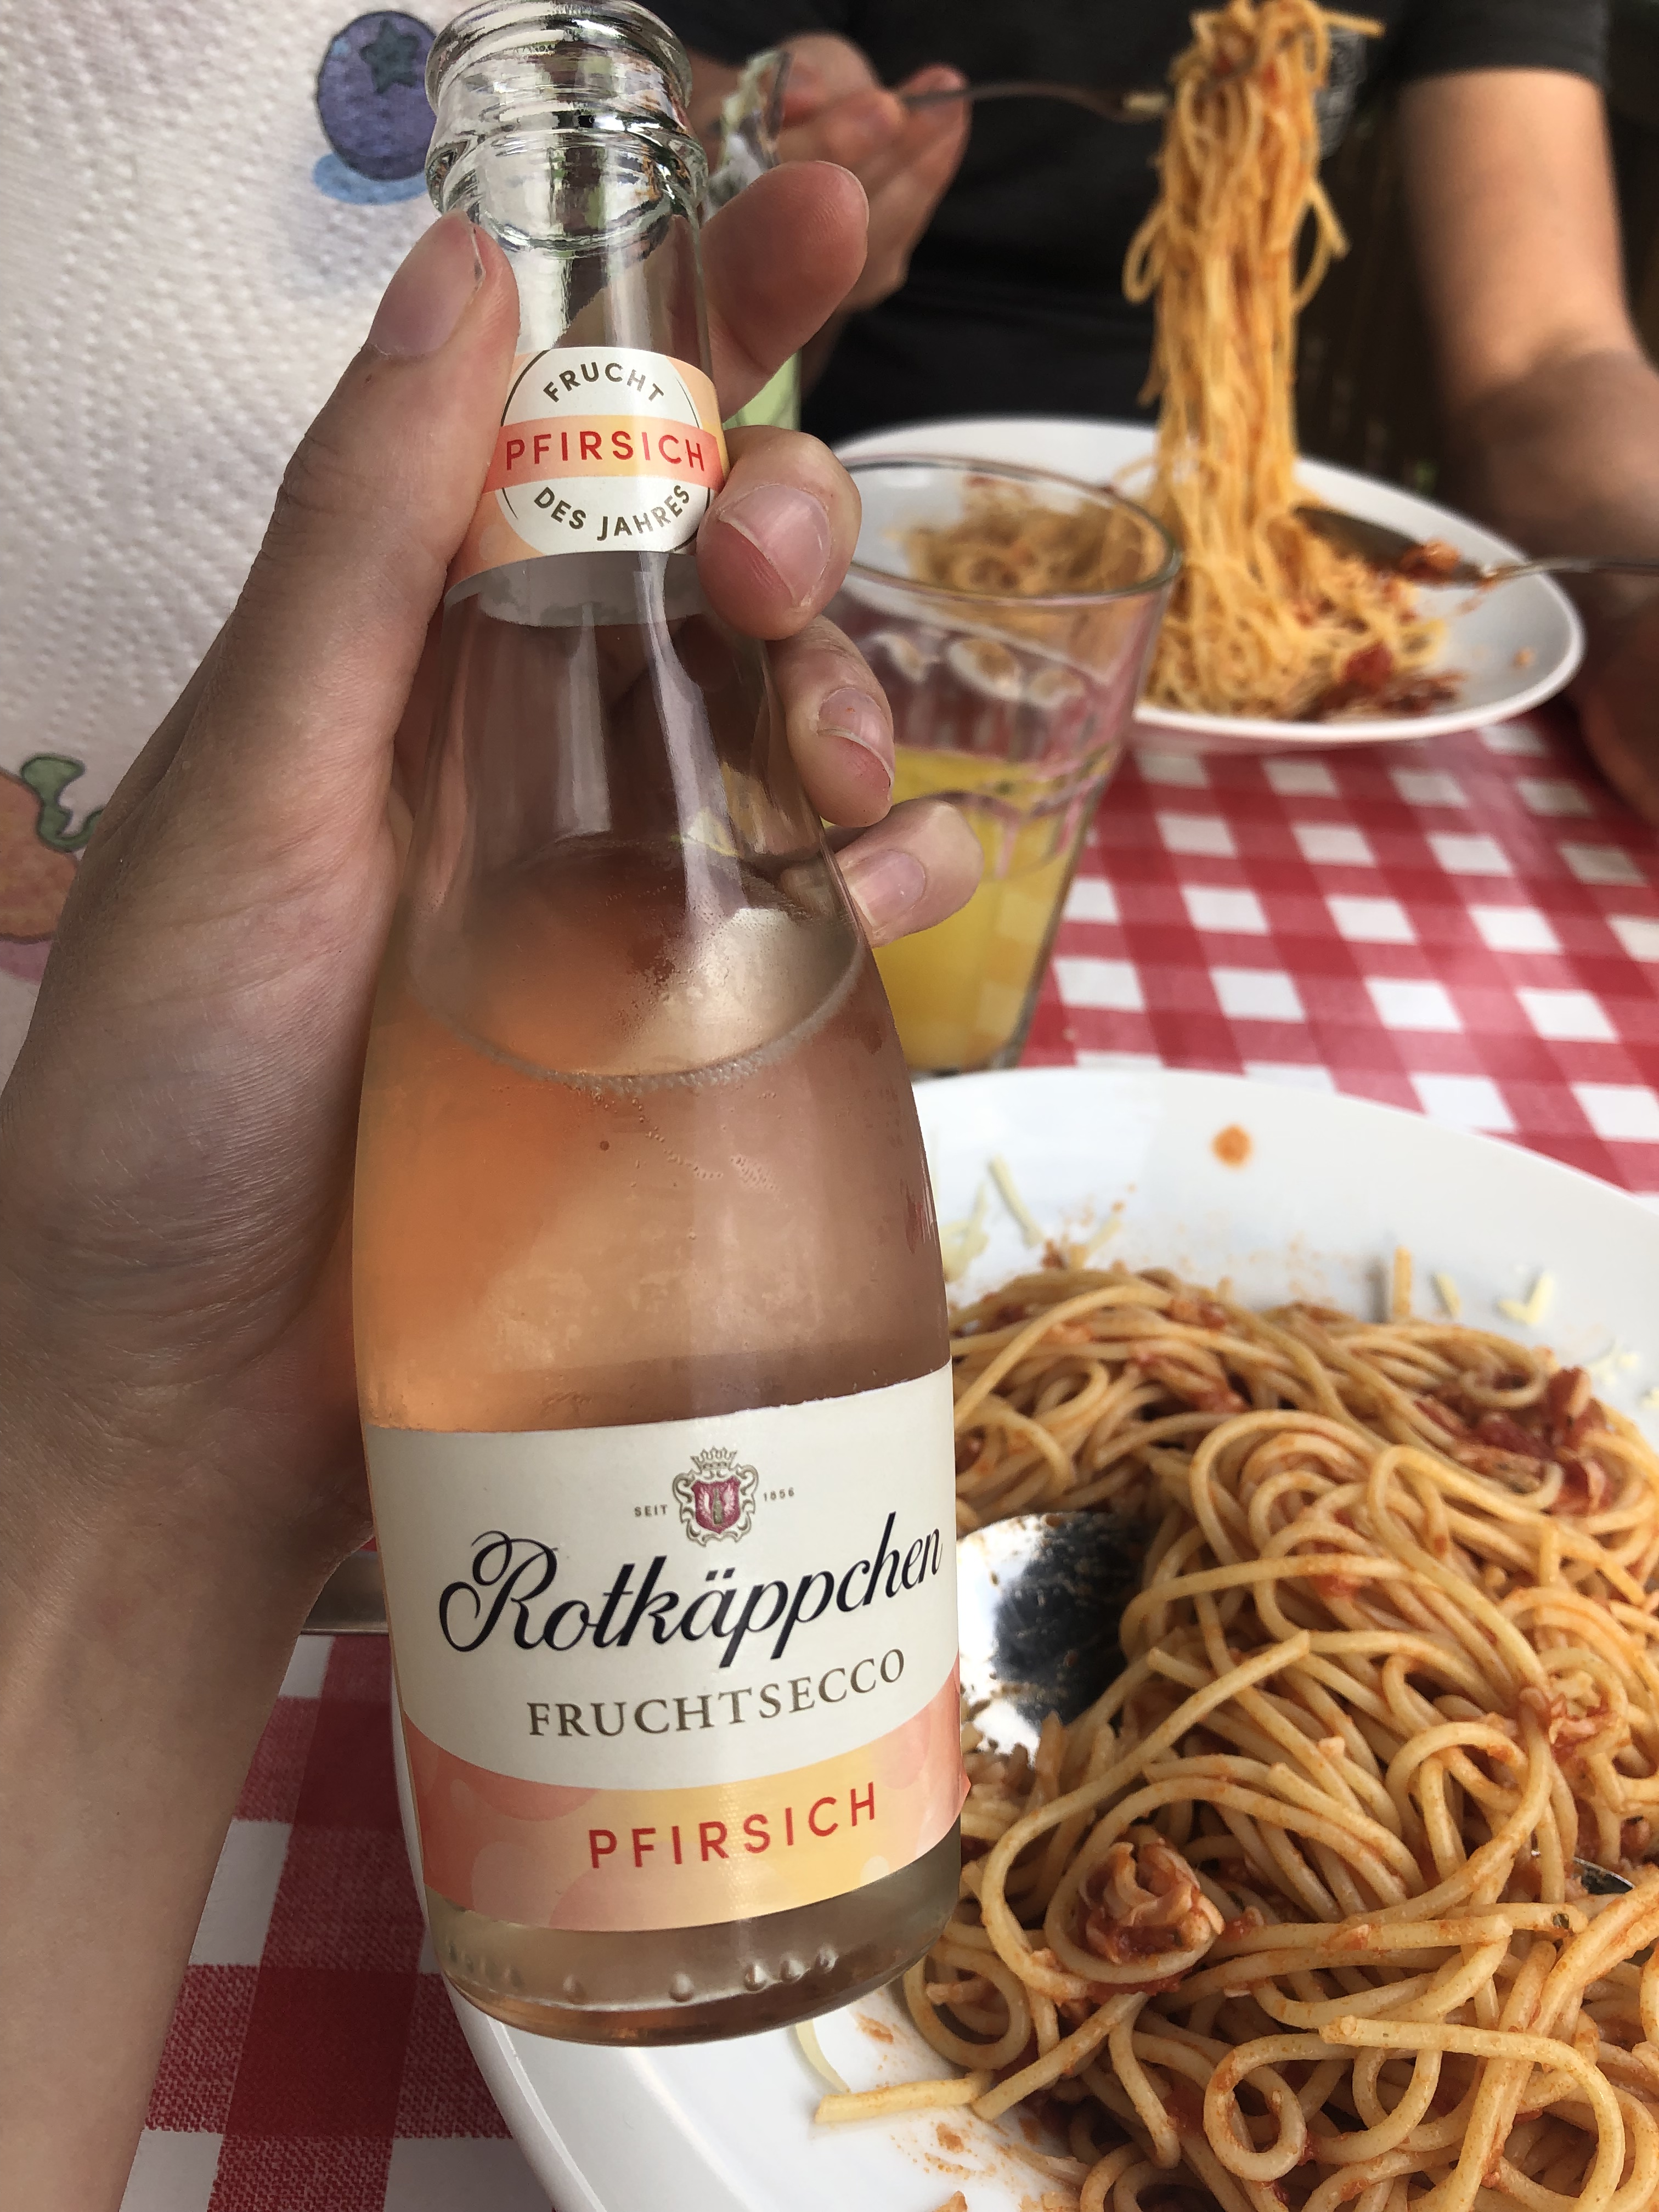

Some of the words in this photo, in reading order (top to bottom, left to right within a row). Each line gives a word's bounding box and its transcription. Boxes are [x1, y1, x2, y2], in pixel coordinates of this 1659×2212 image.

[543, 362, 664, 403] FRUCHT
[506, 431, 704, 471] PFIRSICH
[534, 487, 586, 529] DES
[596, 484, 690, 541] JAHRES
[634, 1504, 668, 1517] SEIT
[763, 1487, 795, 1502] 1856
[439, 1511, 943, 1669] Rotkäppchen
[527, 1647, 905, 1737] FRUCHTSECCO
[589, 1781, 876, 1869] PFIRSICH
